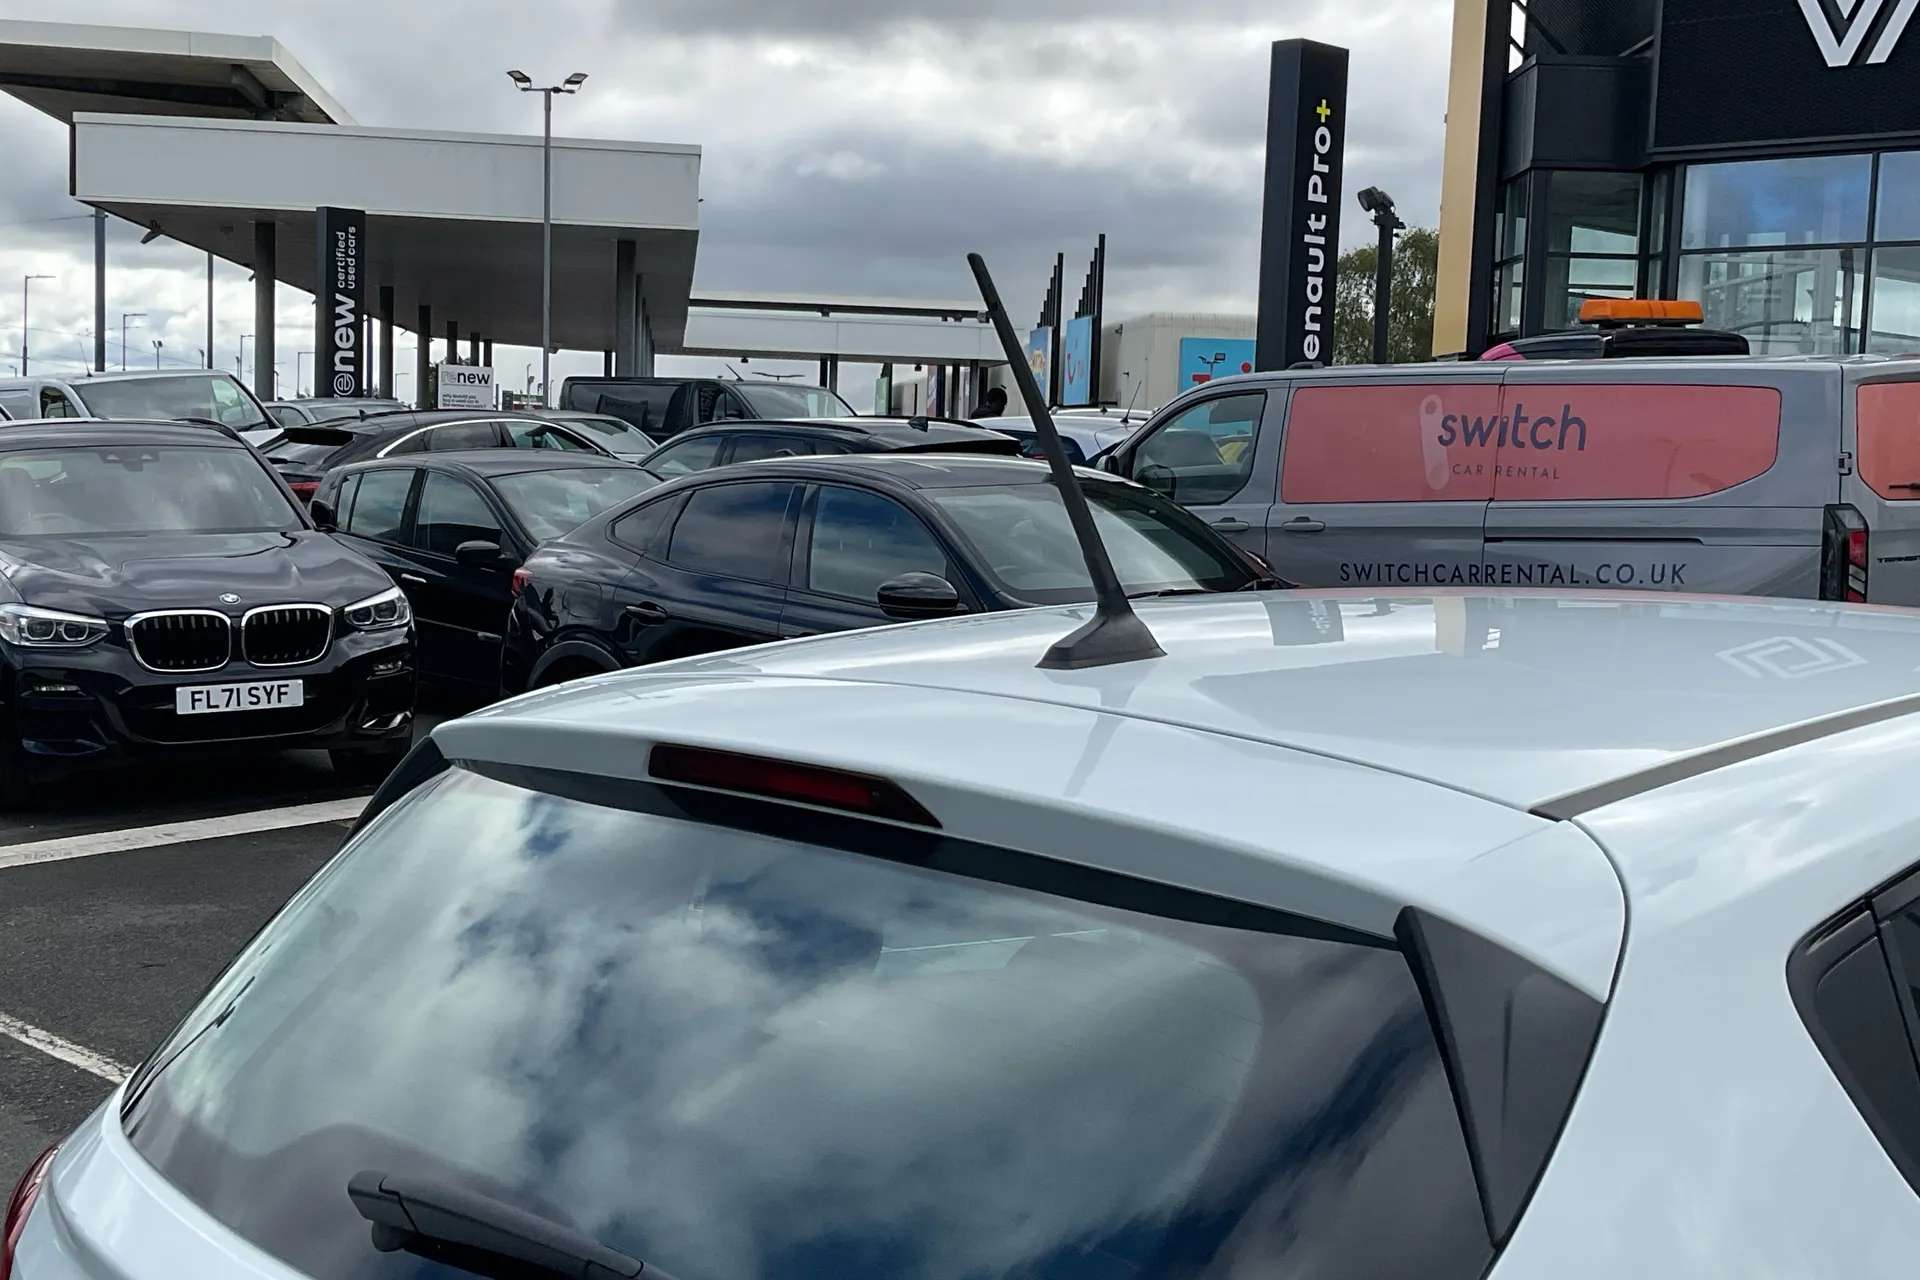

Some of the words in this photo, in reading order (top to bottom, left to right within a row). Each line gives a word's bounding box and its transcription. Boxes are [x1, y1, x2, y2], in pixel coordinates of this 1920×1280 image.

[347, 226, 356, 256] cars
[336, 231, 346, 289] certified
[347, 257, 356, 289] used
[1303, 212, 1327, 360] enault
[333, 292, 356, 398] enew
[1437, 403, 1587, 451] switch
[1452, 463, 1485, 476] CAR
[1494, 465, 1561, 480] RENTAL
[1339, 562, 1688, 585] SWITCHCARRENTAL.CO.UK
[190, 687, 241, 711] FL71
[247, 683, 290, 706] SYF
